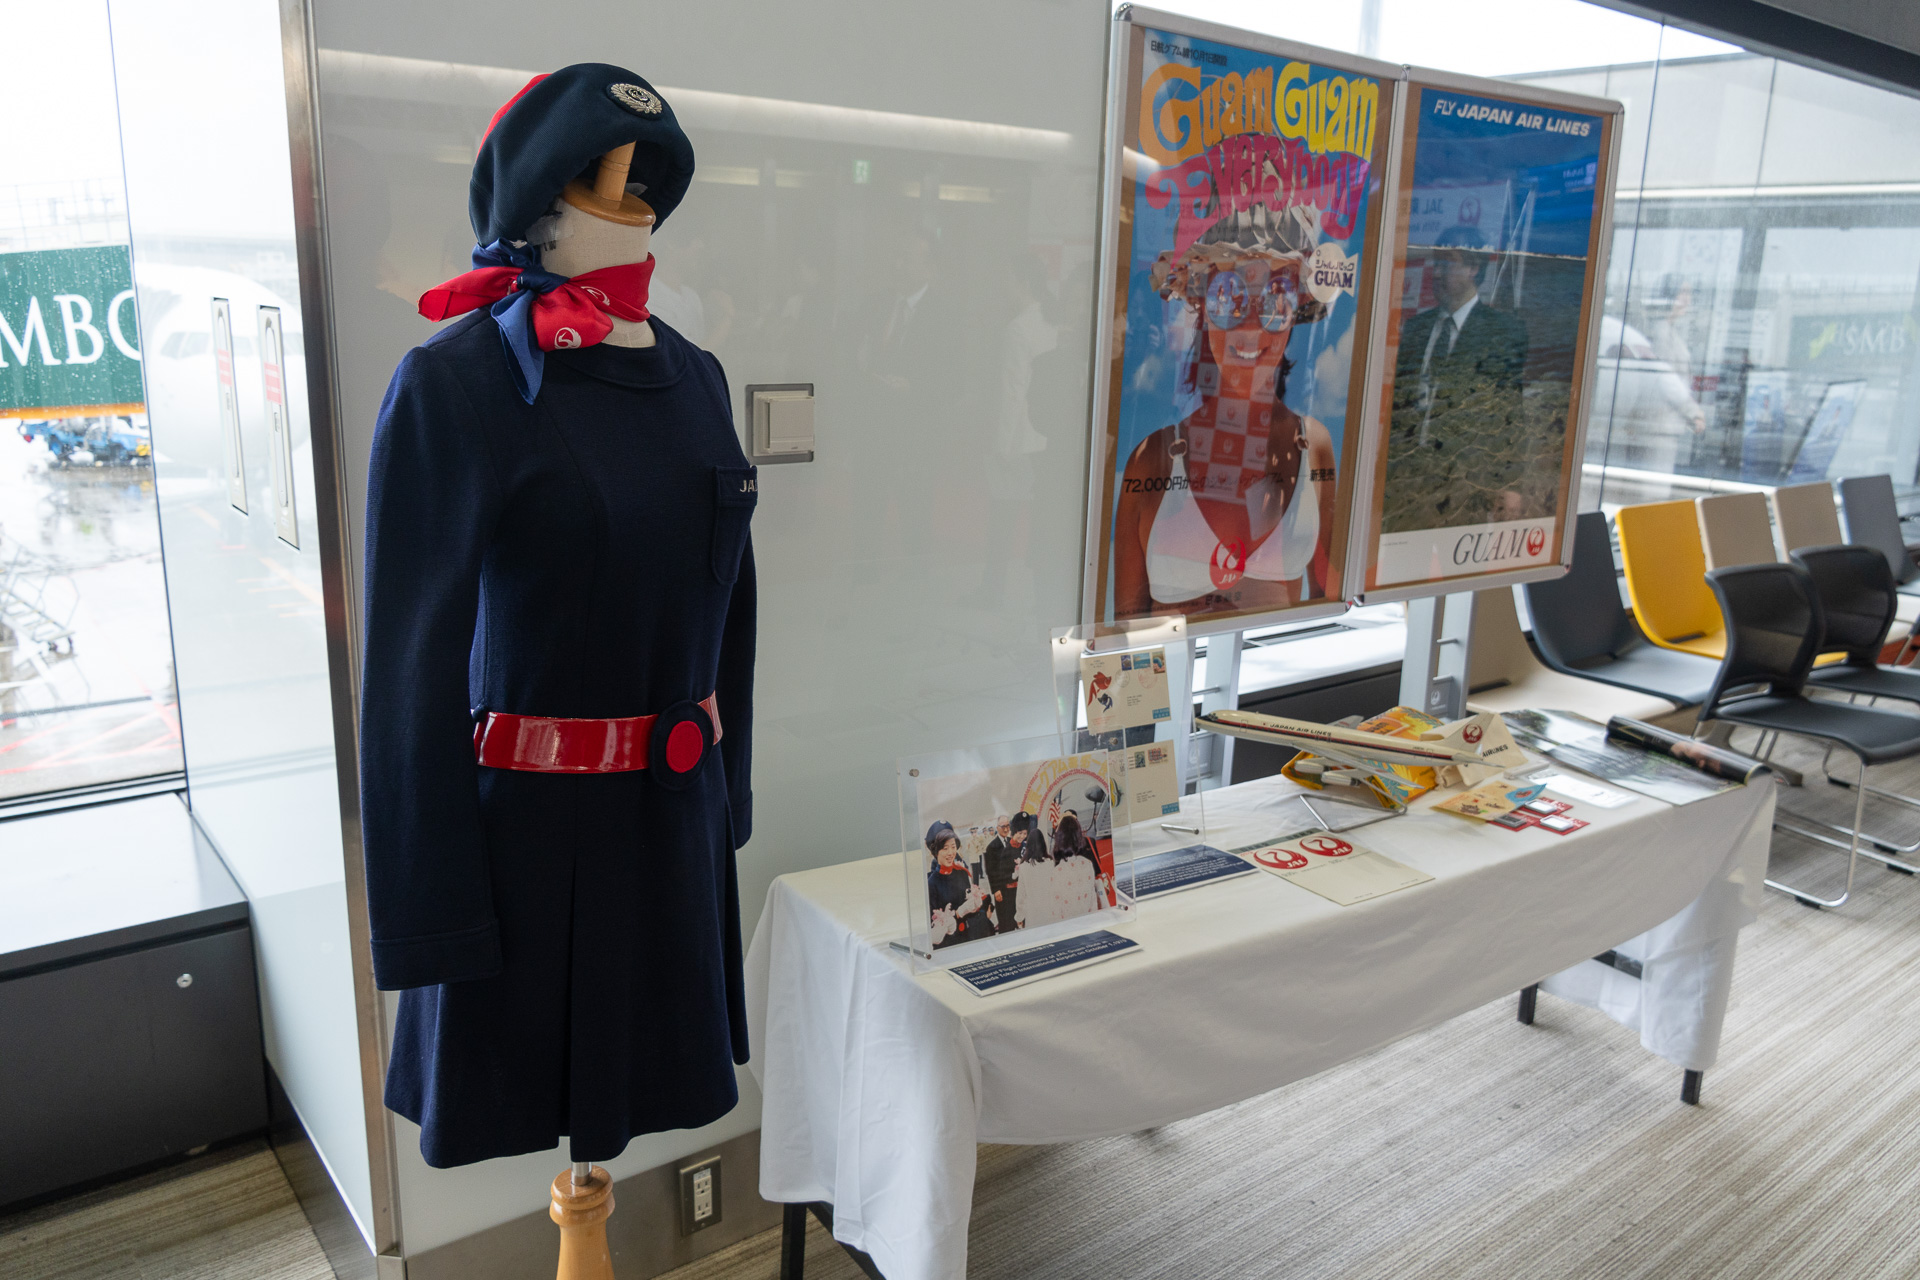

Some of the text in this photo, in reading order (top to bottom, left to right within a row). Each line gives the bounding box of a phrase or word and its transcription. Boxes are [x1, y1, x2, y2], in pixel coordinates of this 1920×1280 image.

[1433, 99, 1591, 137] FLY JAPAN AIR LINES
[1314, 270, 1354, 288] GUAM
[1453, 528, 1528, 566] GUAM
[1269, 723, 1295, 731] JAPAN
[1310, 729, 1332, 737] LINES
[1482, 744, 1509, 758] AIRLINES
[1332, 846, 1351, 856] JAL
[1286, 858, 1306, 869] JAL
